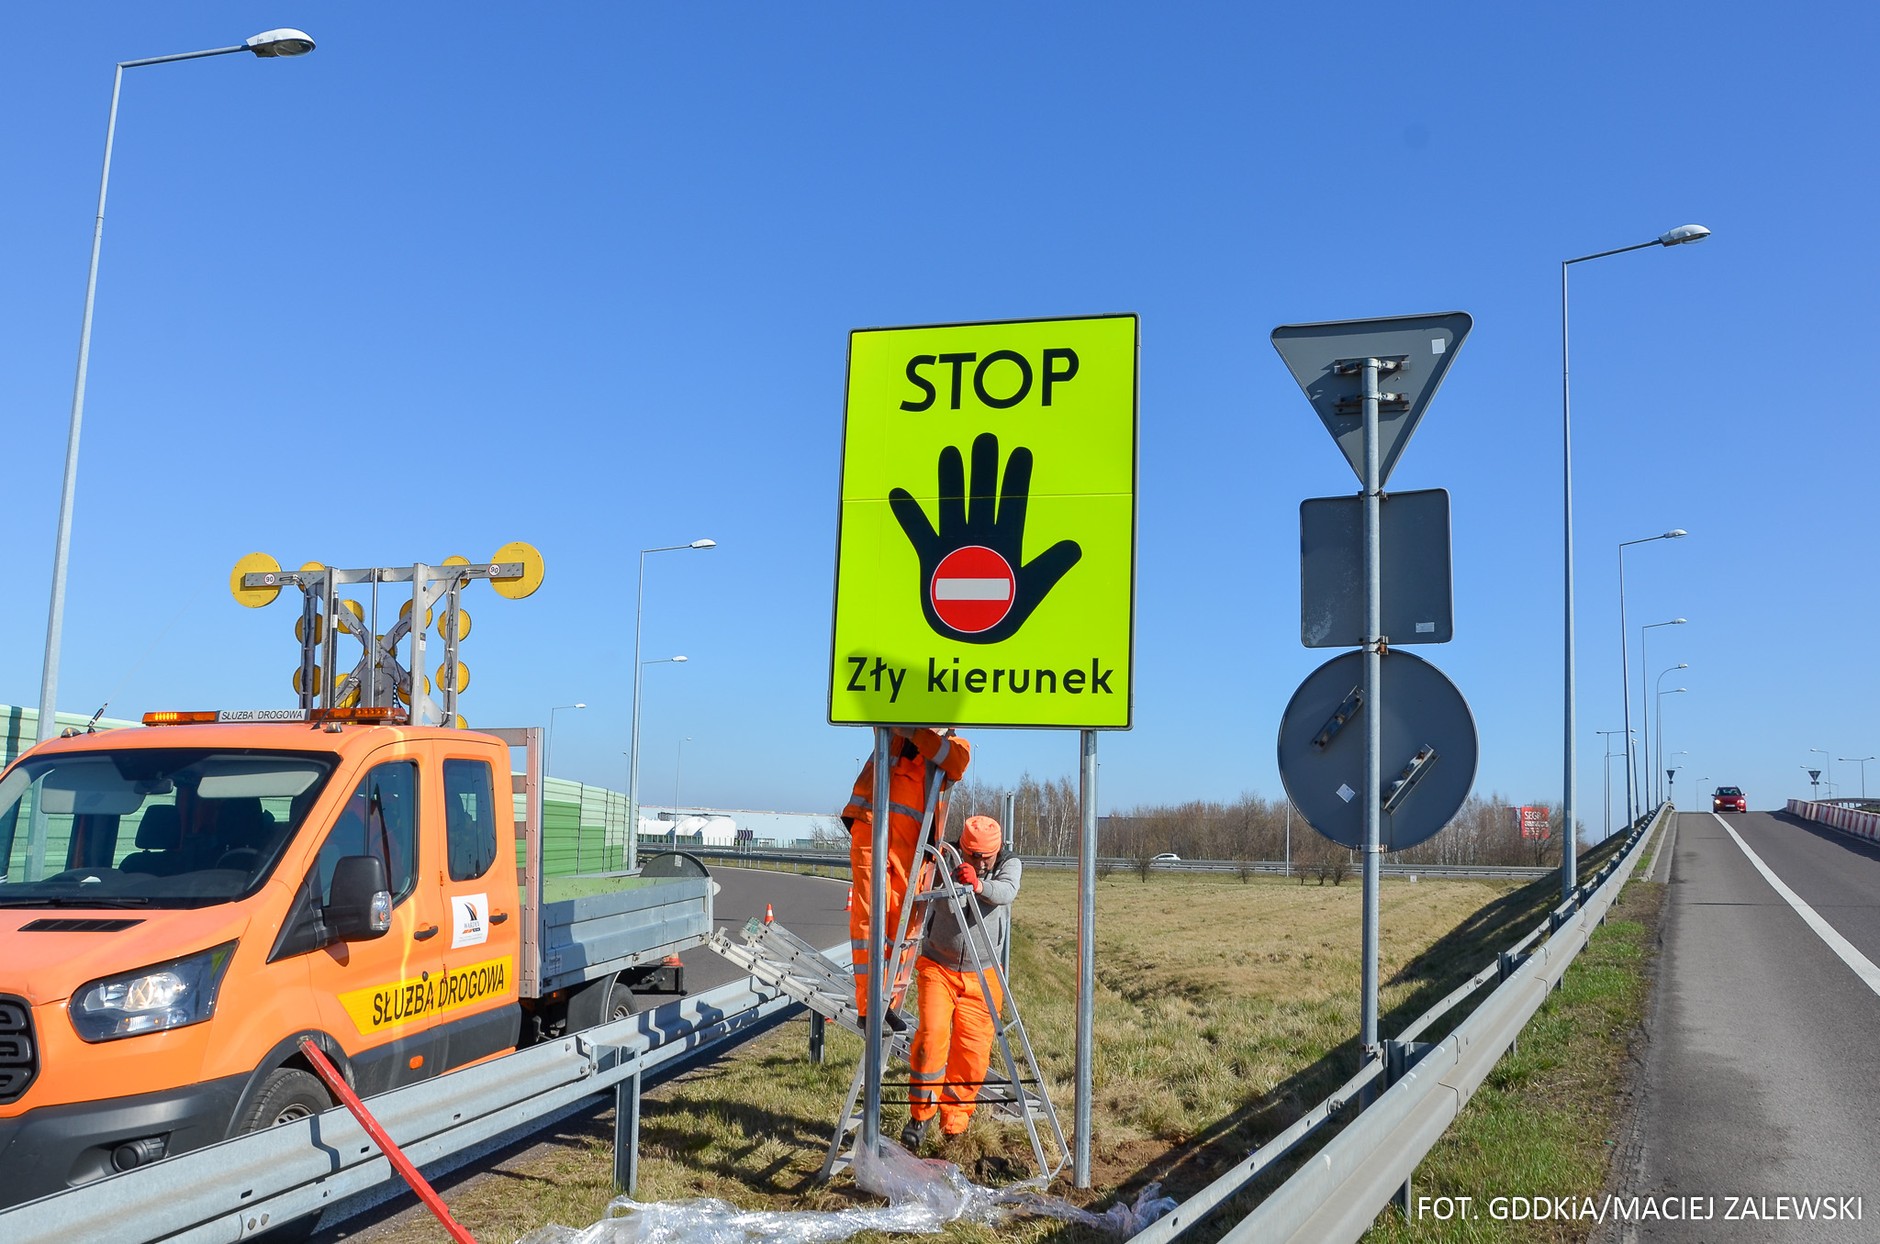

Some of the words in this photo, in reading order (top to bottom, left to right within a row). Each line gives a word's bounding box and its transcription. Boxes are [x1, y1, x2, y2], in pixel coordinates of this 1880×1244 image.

[899, 348, 1079, 412] STOP
[846, 657, 907, 703] Zły
[927, 657, 1114, 694] kierunek
[257, 710, 303, 719] DROGOWA
[438, 963, 504, 1008] DROGOWA
